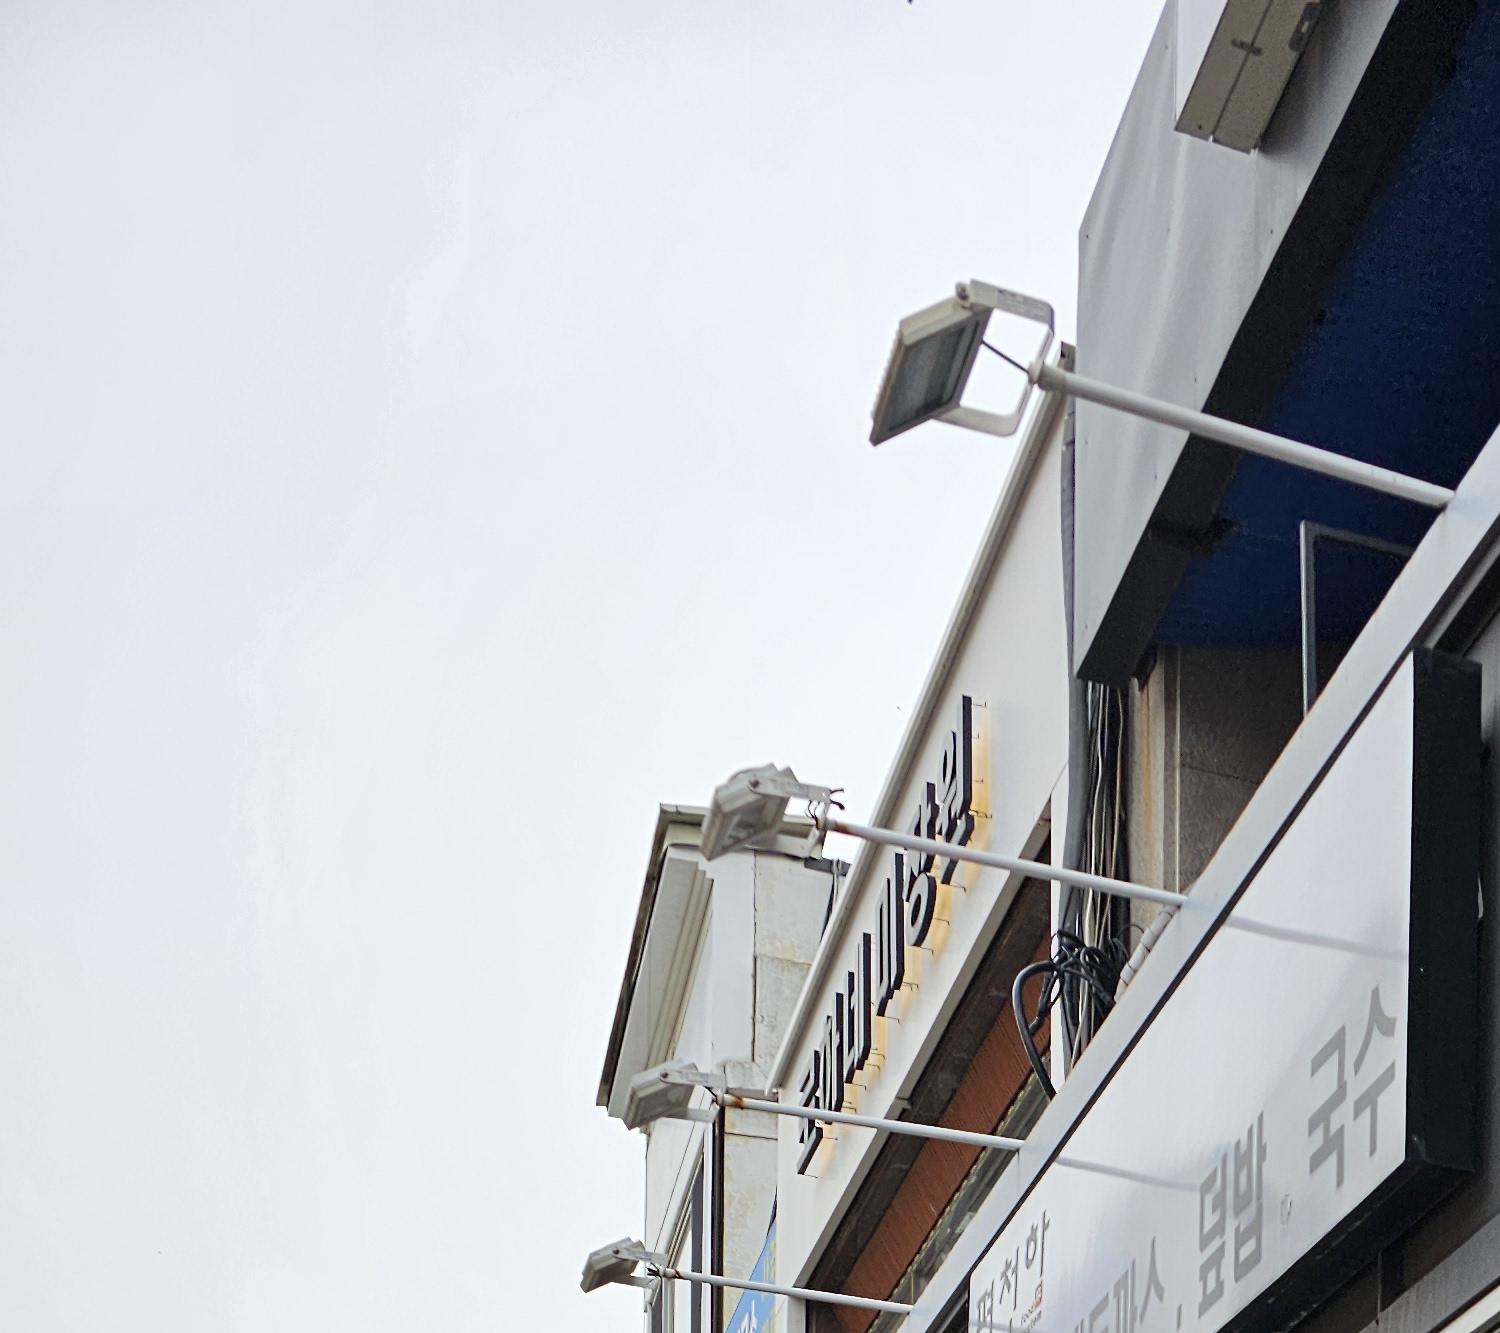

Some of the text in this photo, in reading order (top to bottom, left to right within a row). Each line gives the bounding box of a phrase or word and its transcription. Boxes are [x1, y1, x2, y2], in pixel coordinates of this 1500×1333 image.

[876, 695, 973, 1018] 미장원
[1198, 1111, 1267, 1320] 덮밥
[1307, 985, 1398, 1189] 국수
